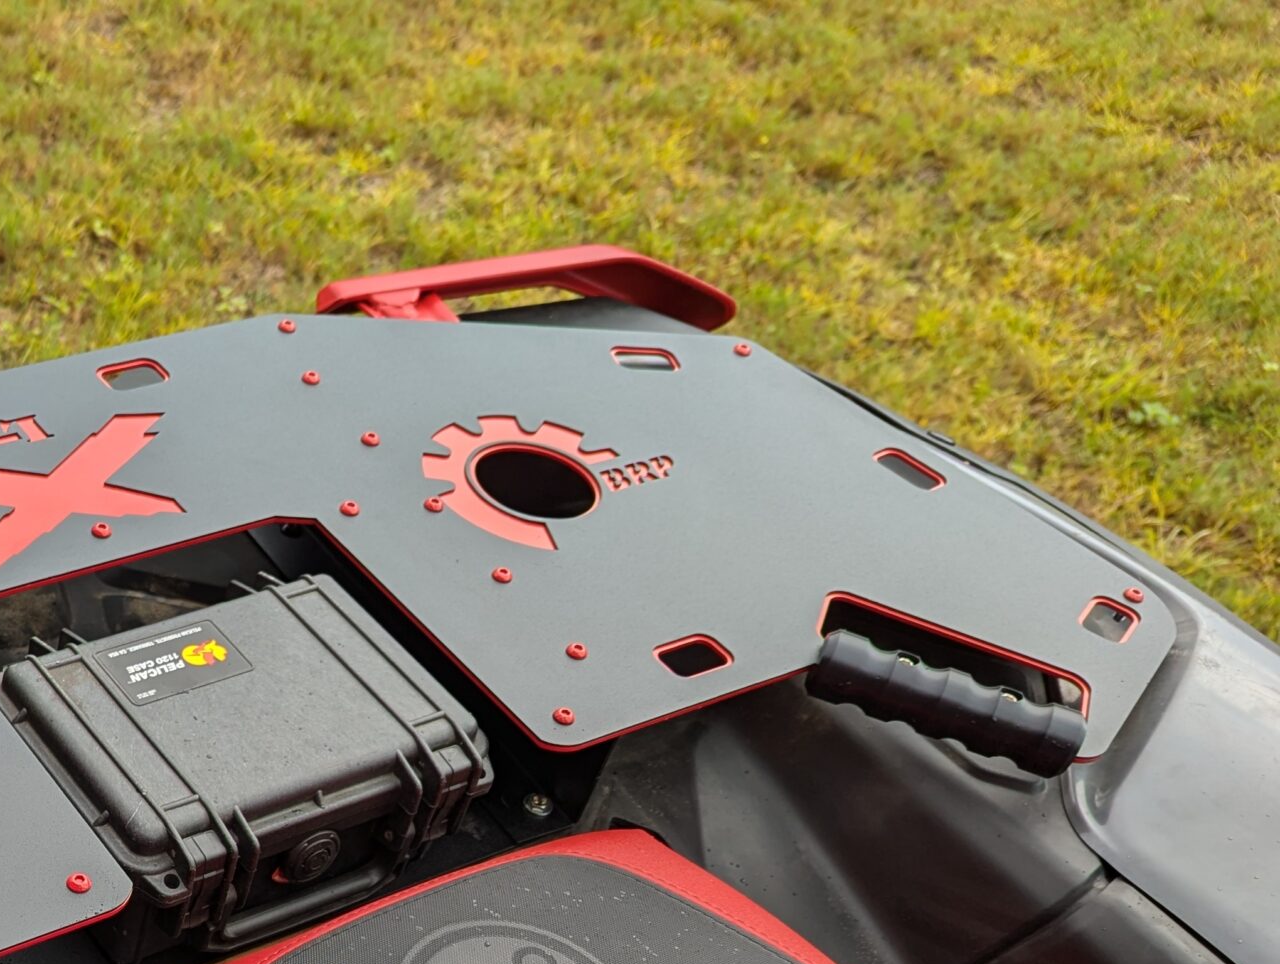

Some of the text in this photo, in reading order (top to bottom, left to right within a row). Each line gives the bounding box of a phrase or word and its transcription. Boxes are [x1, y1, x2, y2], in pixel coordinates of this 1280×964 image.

[599, 455, 674, 492] BRP
[126, 652, 179, 674] 1120 CASE
[129, 659, 185, 682] PELICAN
